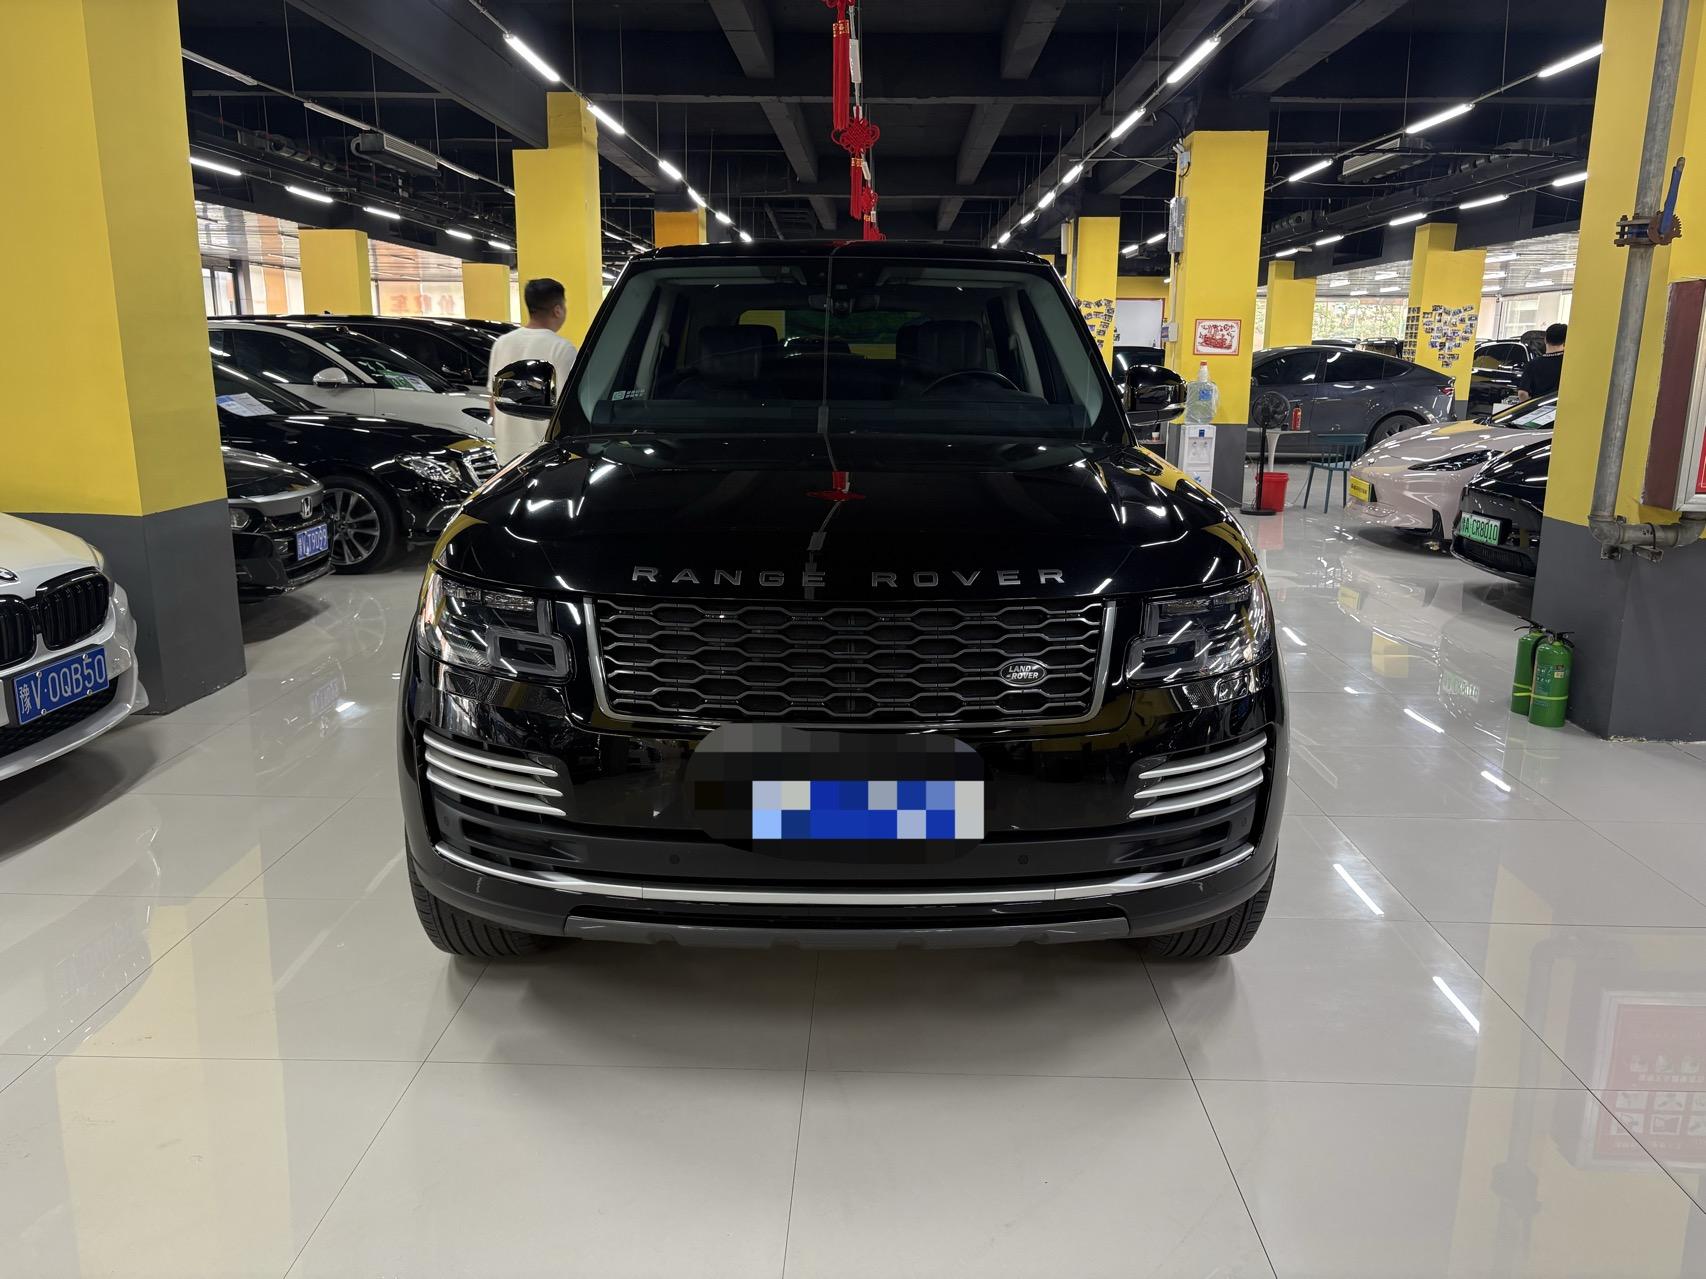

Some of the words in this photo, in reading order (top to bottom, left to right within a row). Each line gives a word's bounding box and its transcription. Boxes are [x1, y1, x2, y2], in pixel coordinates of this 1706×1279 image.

[632, 566, 825, 587] RANGE
[871, 569, 1065, 588] ROVER
[1008, 665, 1031, 673] LAND
[1011, 672, 1039, 680] ROVER
